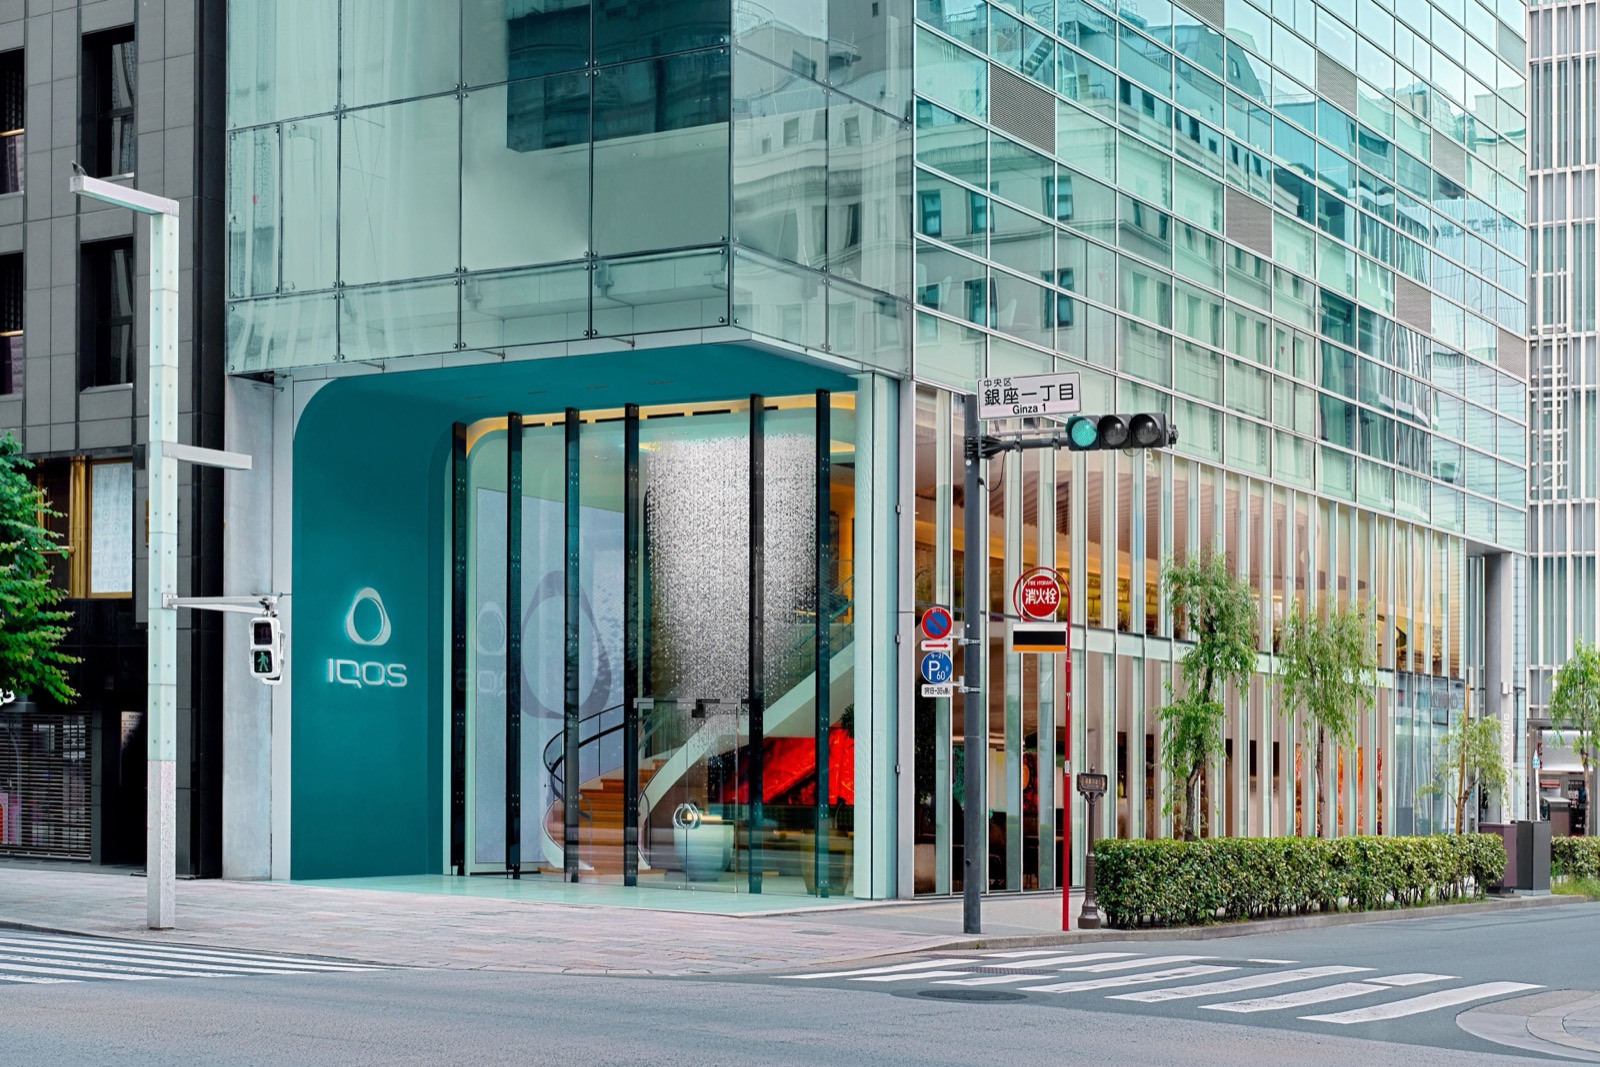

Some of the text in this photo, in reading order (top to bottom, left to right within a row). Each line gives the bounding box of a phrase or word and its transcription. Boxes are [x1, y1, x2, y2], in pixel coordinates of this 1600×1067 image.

[984, 377, 1012, 388] 中央区
[984, 383, 1074, 406] 銀座一丁目
[1012, 402, 1047, 415] Ginza 1
[1025, 587, 1057, 605] 消火栓
[328, 658, 408, 689] IQOS
[928, 660, 941, 681] P
[1503, 713, 1511, 747] GINZA
